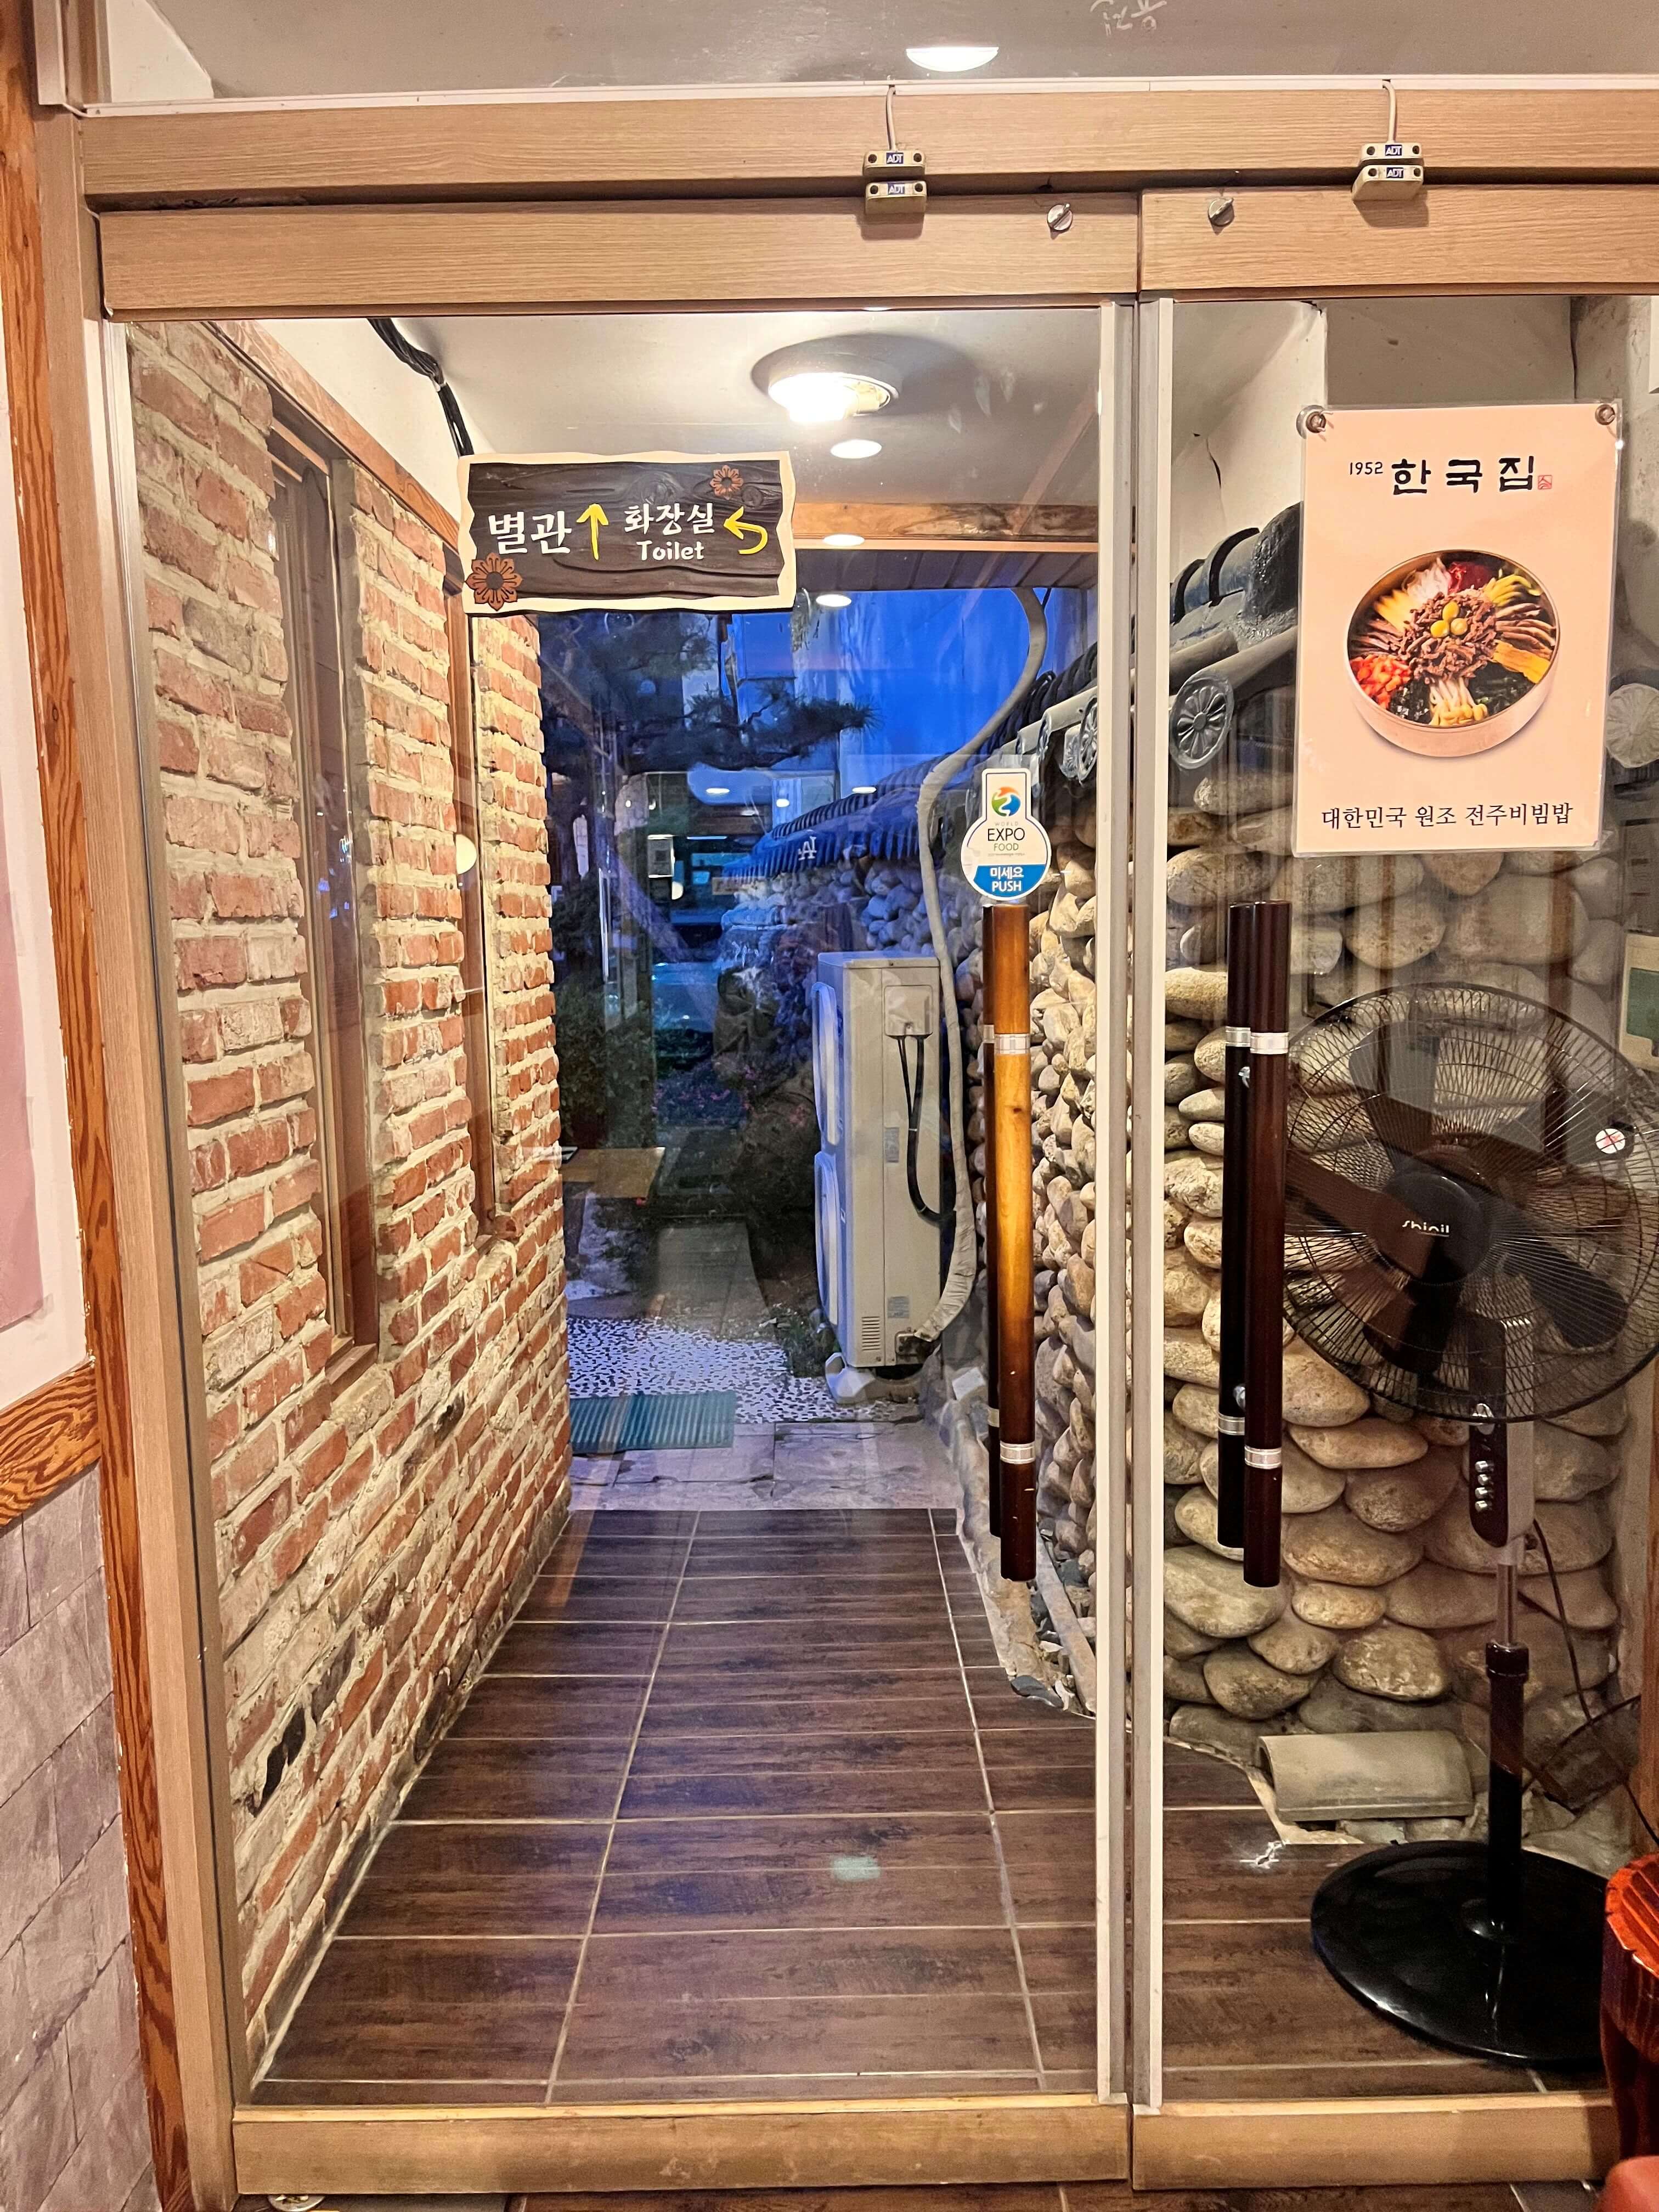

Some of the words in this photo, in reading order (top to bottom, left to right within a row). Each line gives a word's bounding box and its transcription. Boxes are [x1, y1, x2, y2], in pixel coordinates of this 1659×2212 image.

[1385, 146, 1402, 155] ADT
[887, 154, 904, 163] ADT
[1387, 168, 1403, 178] ADT
[889, 185, 905, 194] ADT
[1349, 461, 1384, 475] 1952
[624, 503, 715, 536] 화장실
[488, 510, 572, 556] 별관
[636, 540, 705, 561] Toilet
[1322, 806, 1407, 830] 대한민국
[1414, 805, 1457, 827] 원조
[1465, 802, 1573, 826] 전주비빔밥
[987, 827, 1025, 842] EXPO
[994, 843, 1019, 851] FOOD
[990, 867, 1024, 879] 미세요
[992, 881, 1022, 892] PUSH
